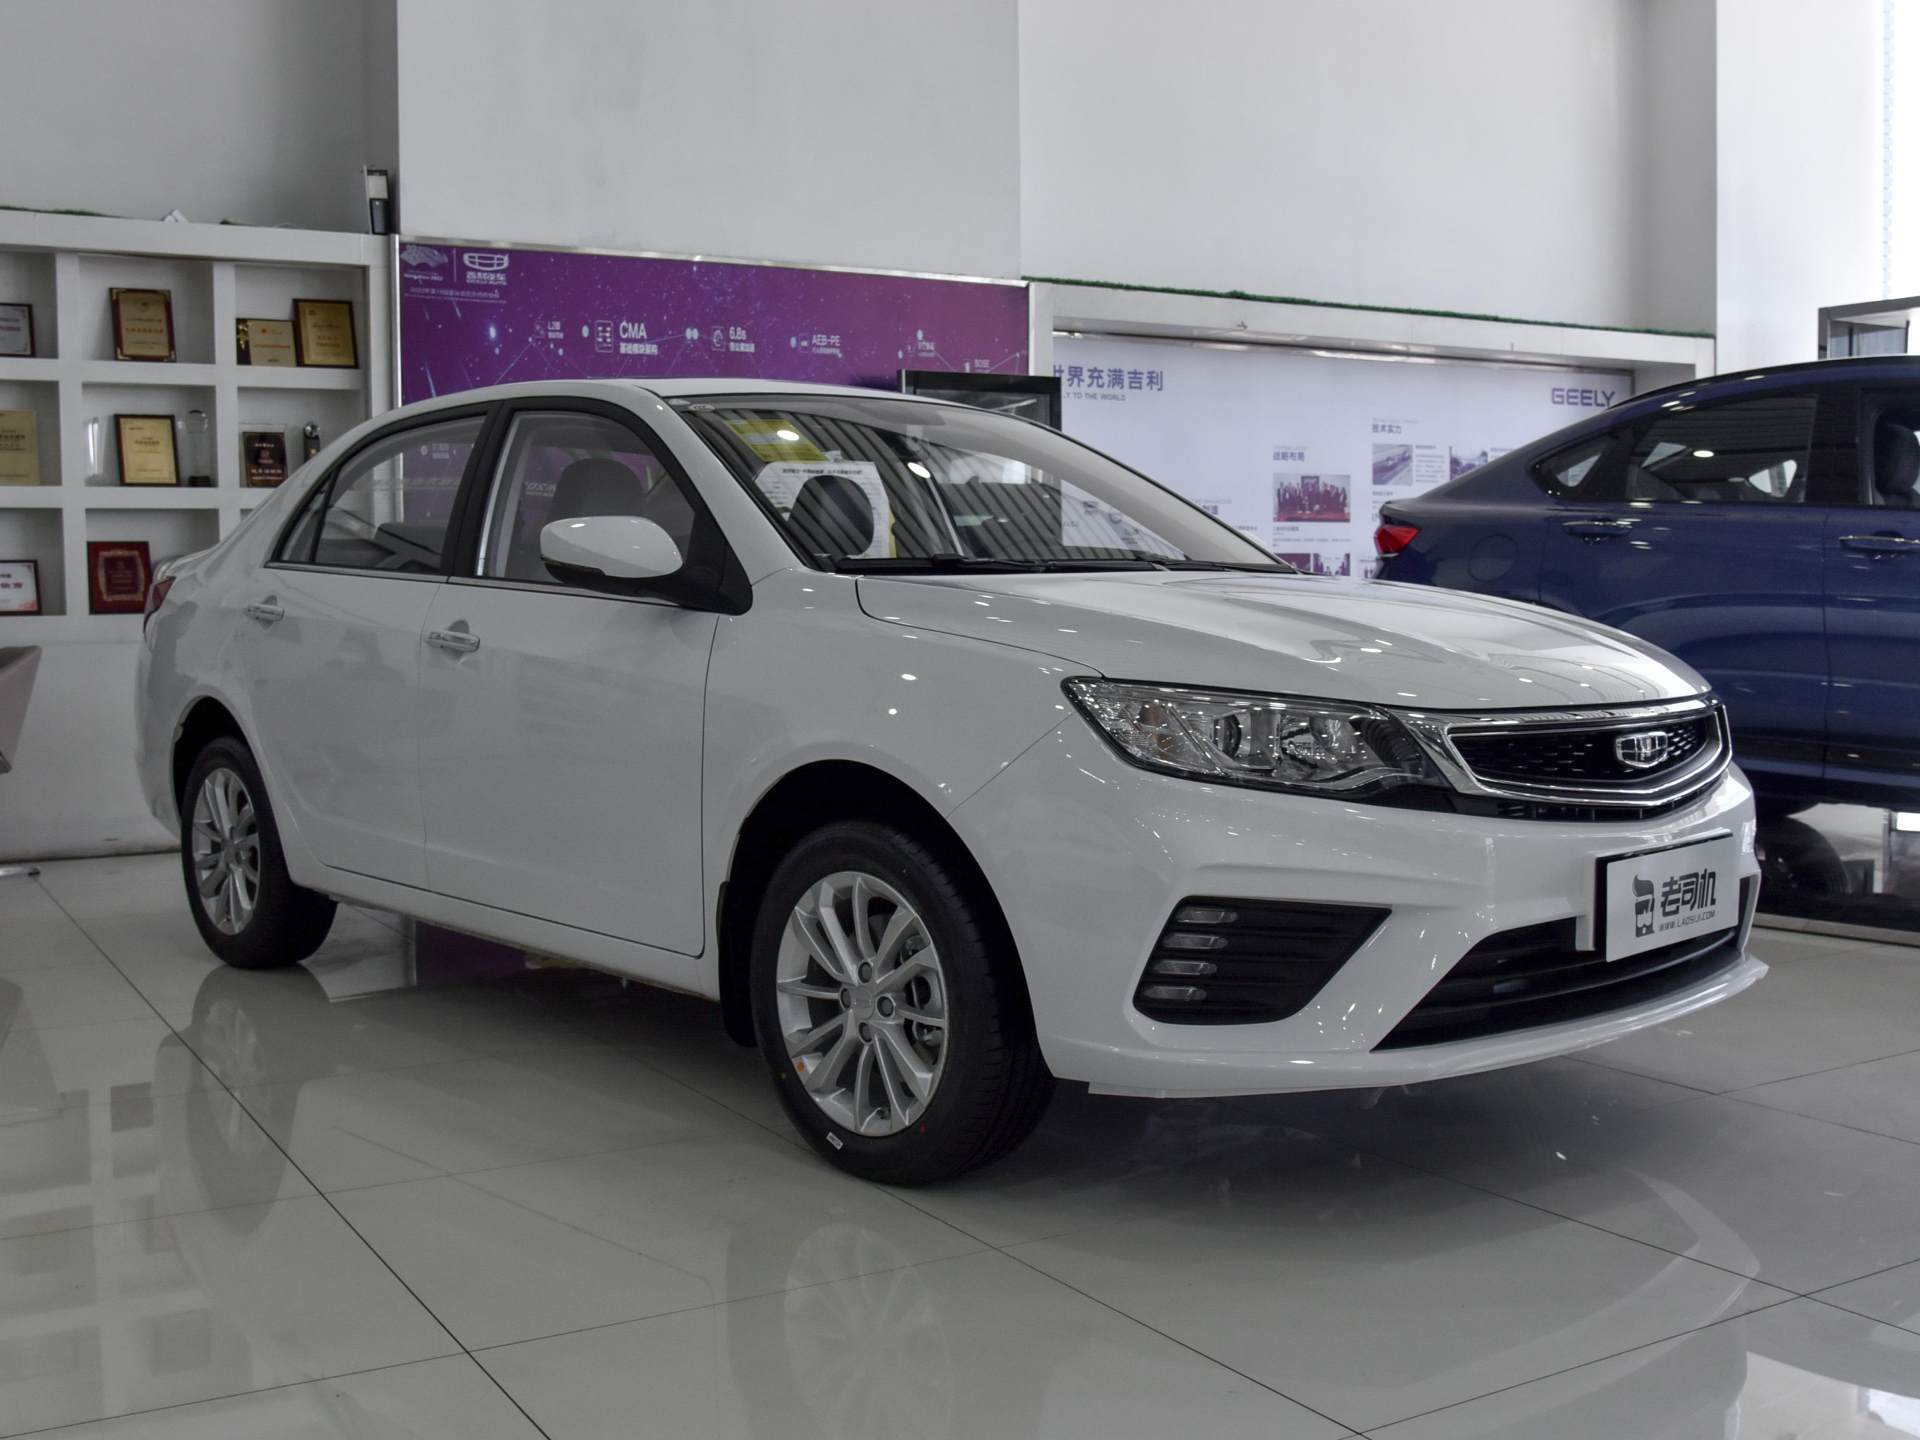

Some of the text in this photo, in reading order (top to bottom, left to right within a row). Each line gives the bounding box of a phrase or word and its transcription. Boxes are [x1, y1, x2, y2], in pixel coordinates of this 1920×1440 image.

[619, 321, 648, 339] CMA
[1551, 387, 1616, 409] GEELY
[1660, 868, 1717, 918] 老司机
